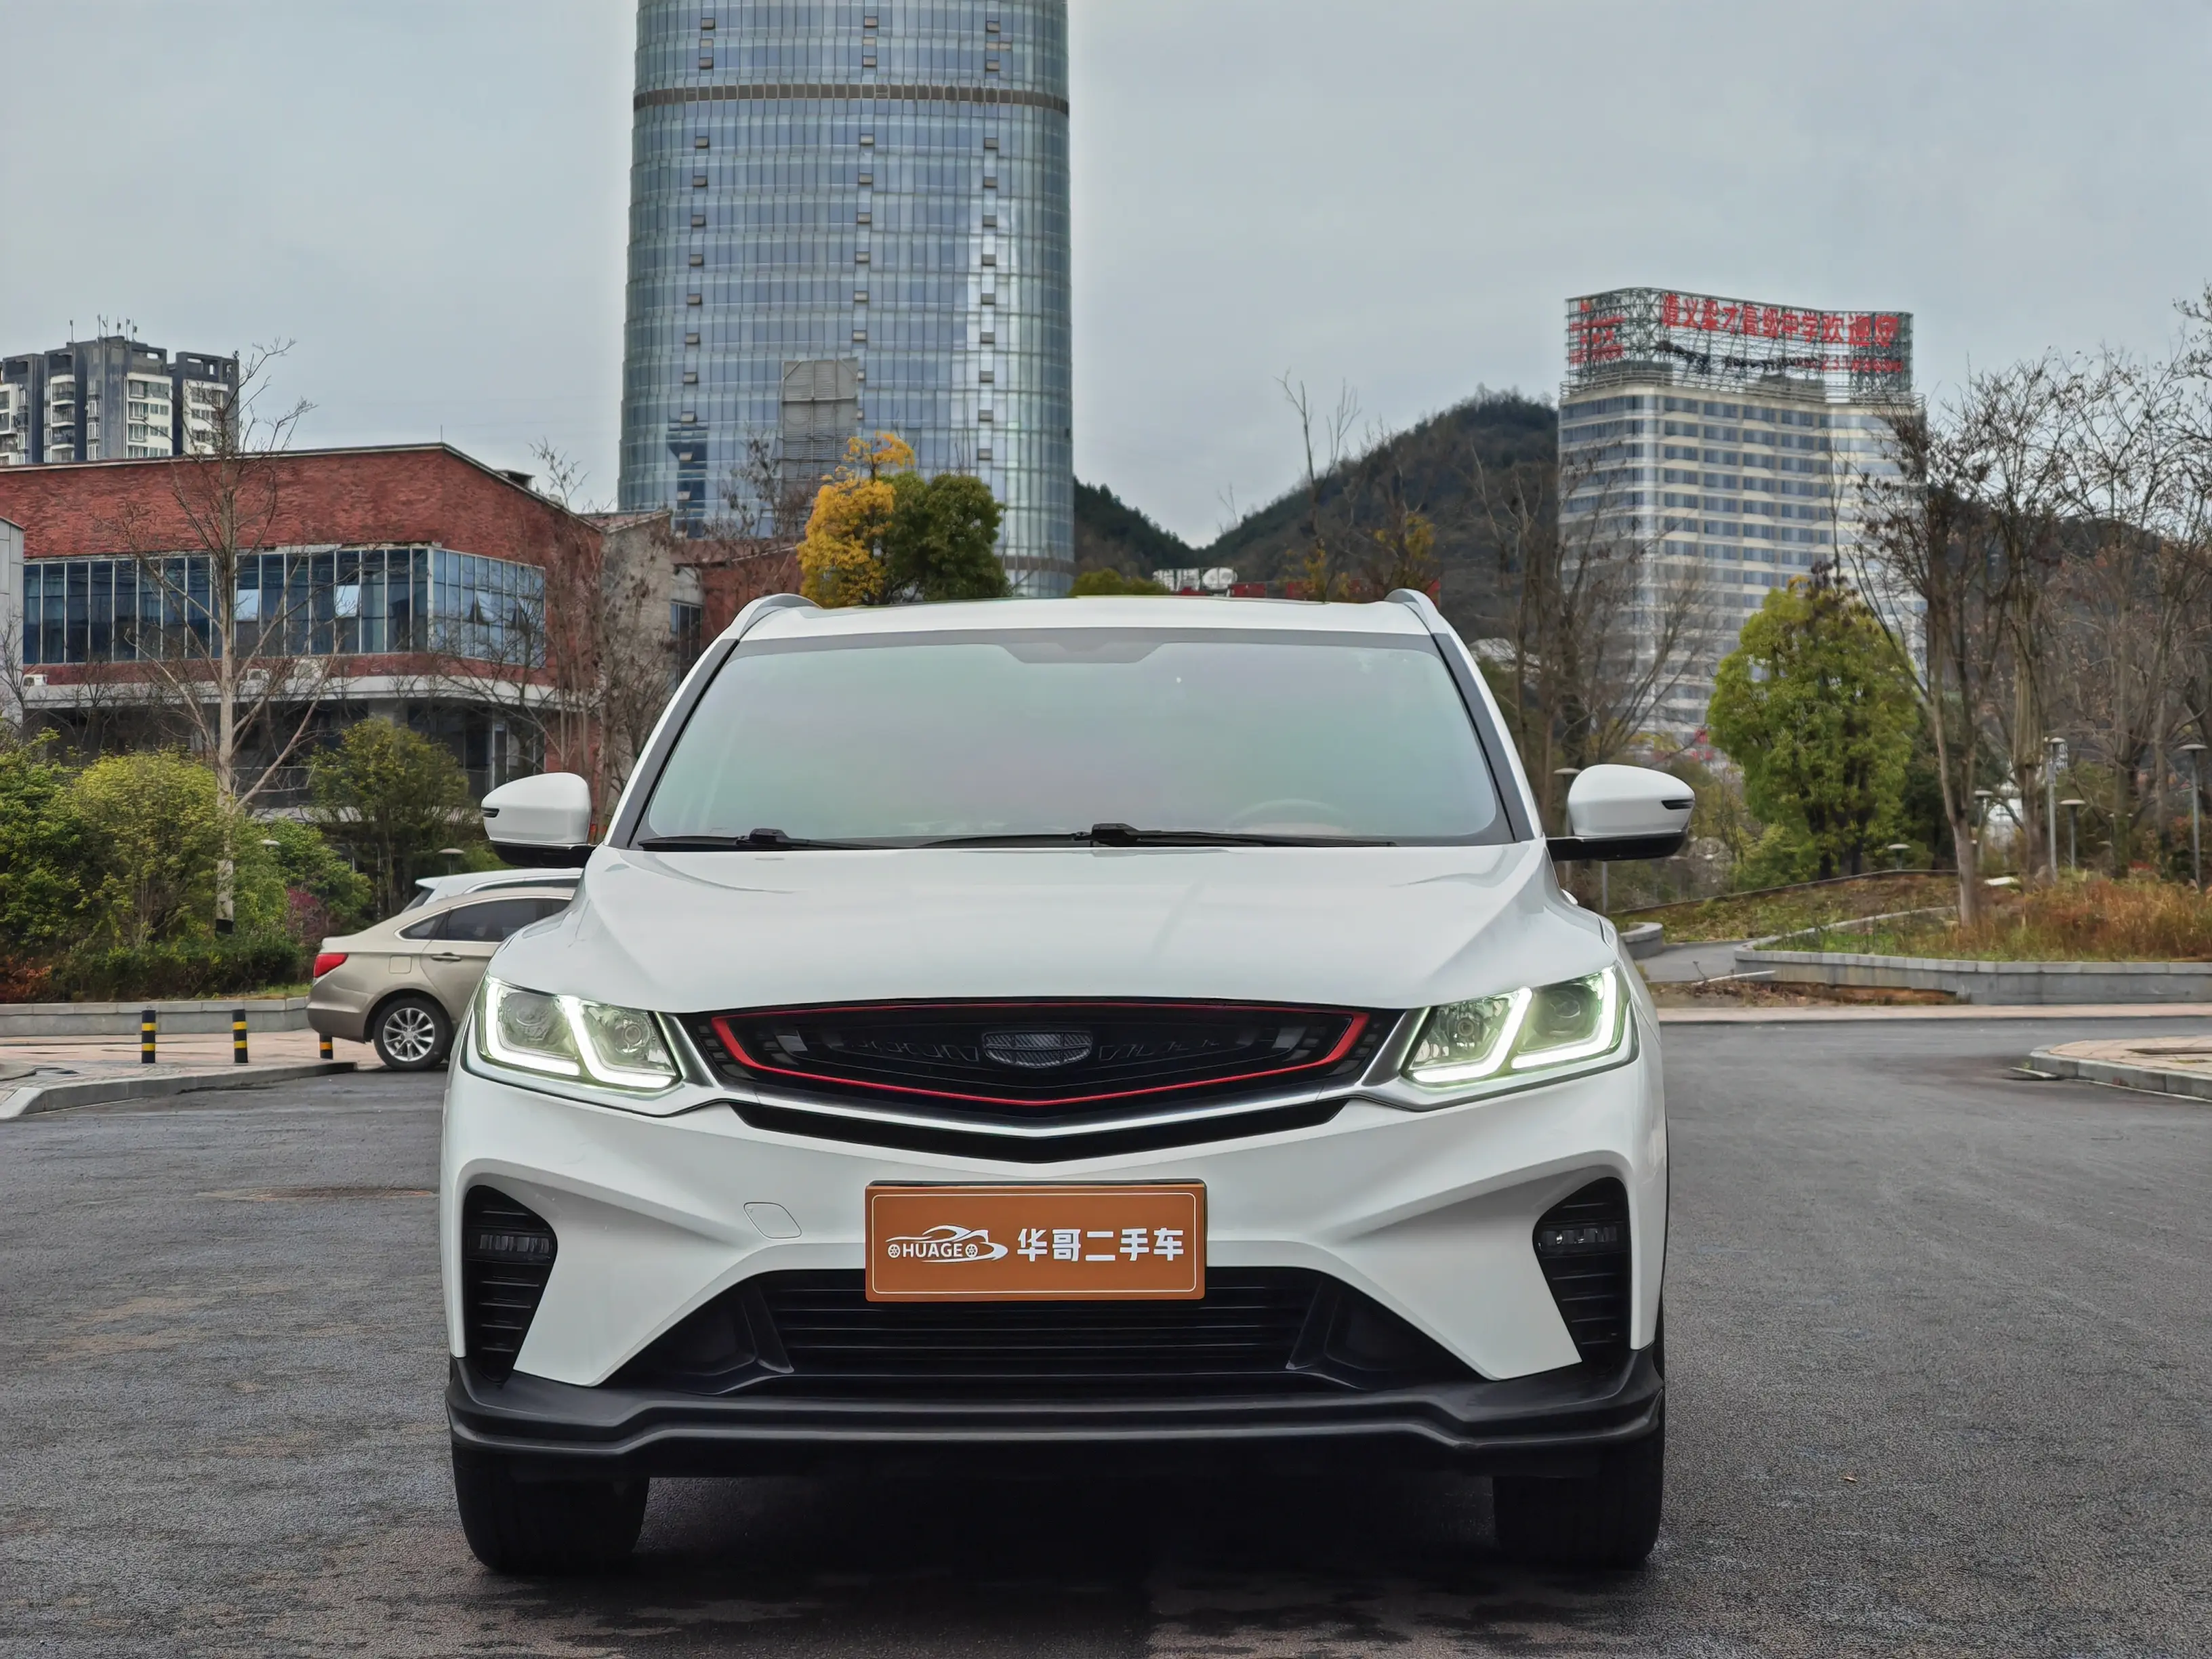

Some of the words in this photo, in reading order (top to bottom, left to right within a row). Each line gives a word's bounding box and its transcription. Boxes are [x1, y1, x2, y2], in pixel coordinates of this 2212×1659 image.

[902, 1243, 963, 1258] HUAGE
[1017, 1227, 1185, 1262] 华哥二手车
